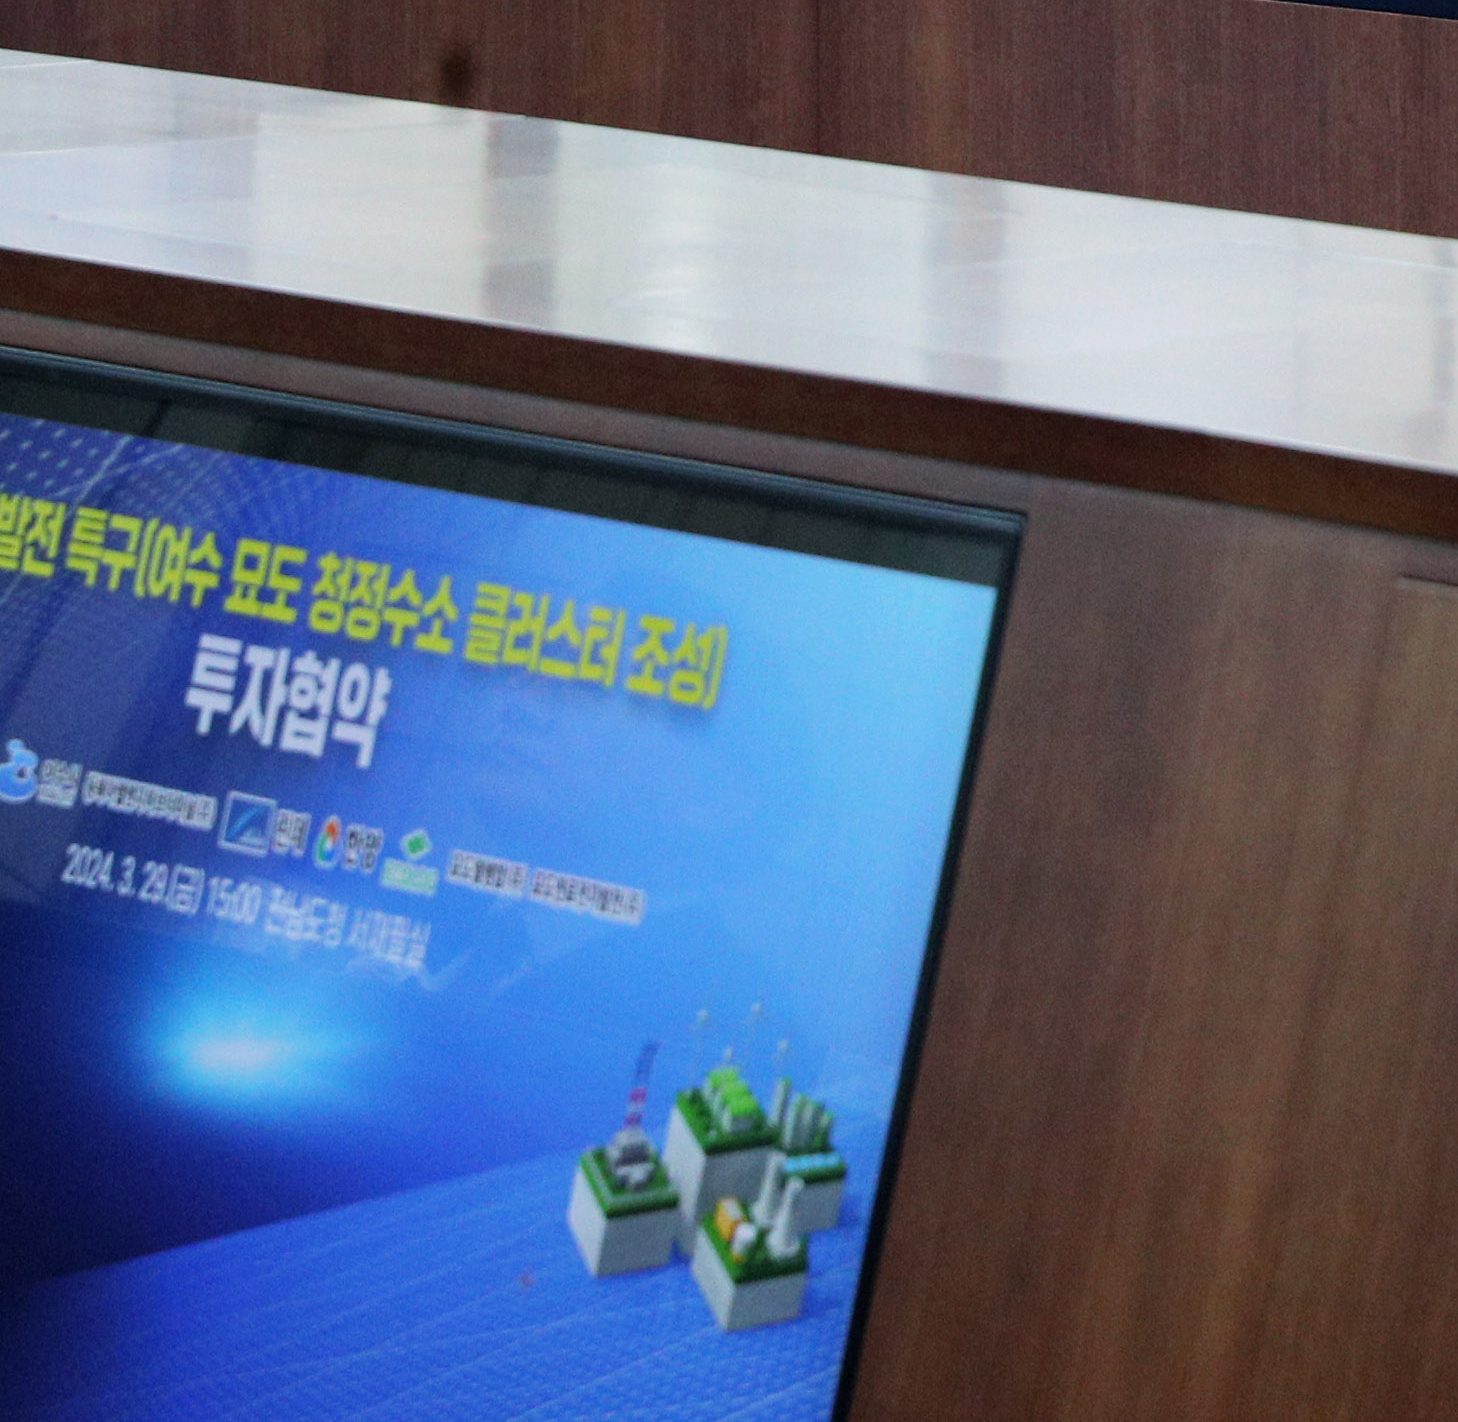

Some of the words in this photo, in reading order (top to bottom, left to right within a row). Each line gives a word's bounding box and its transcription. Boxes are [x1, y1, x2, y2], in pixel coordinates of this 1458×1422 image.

[65, 505, 224, 608] 특구(여수
[222, 538, 305, 625] 묘도
[308, 554, 459, 655] 청정수소
[466, 582, 622, 687] 클러스터
[626, 616, 728, 709] 조성)
[184, 633, 392, 770] 투자협약
